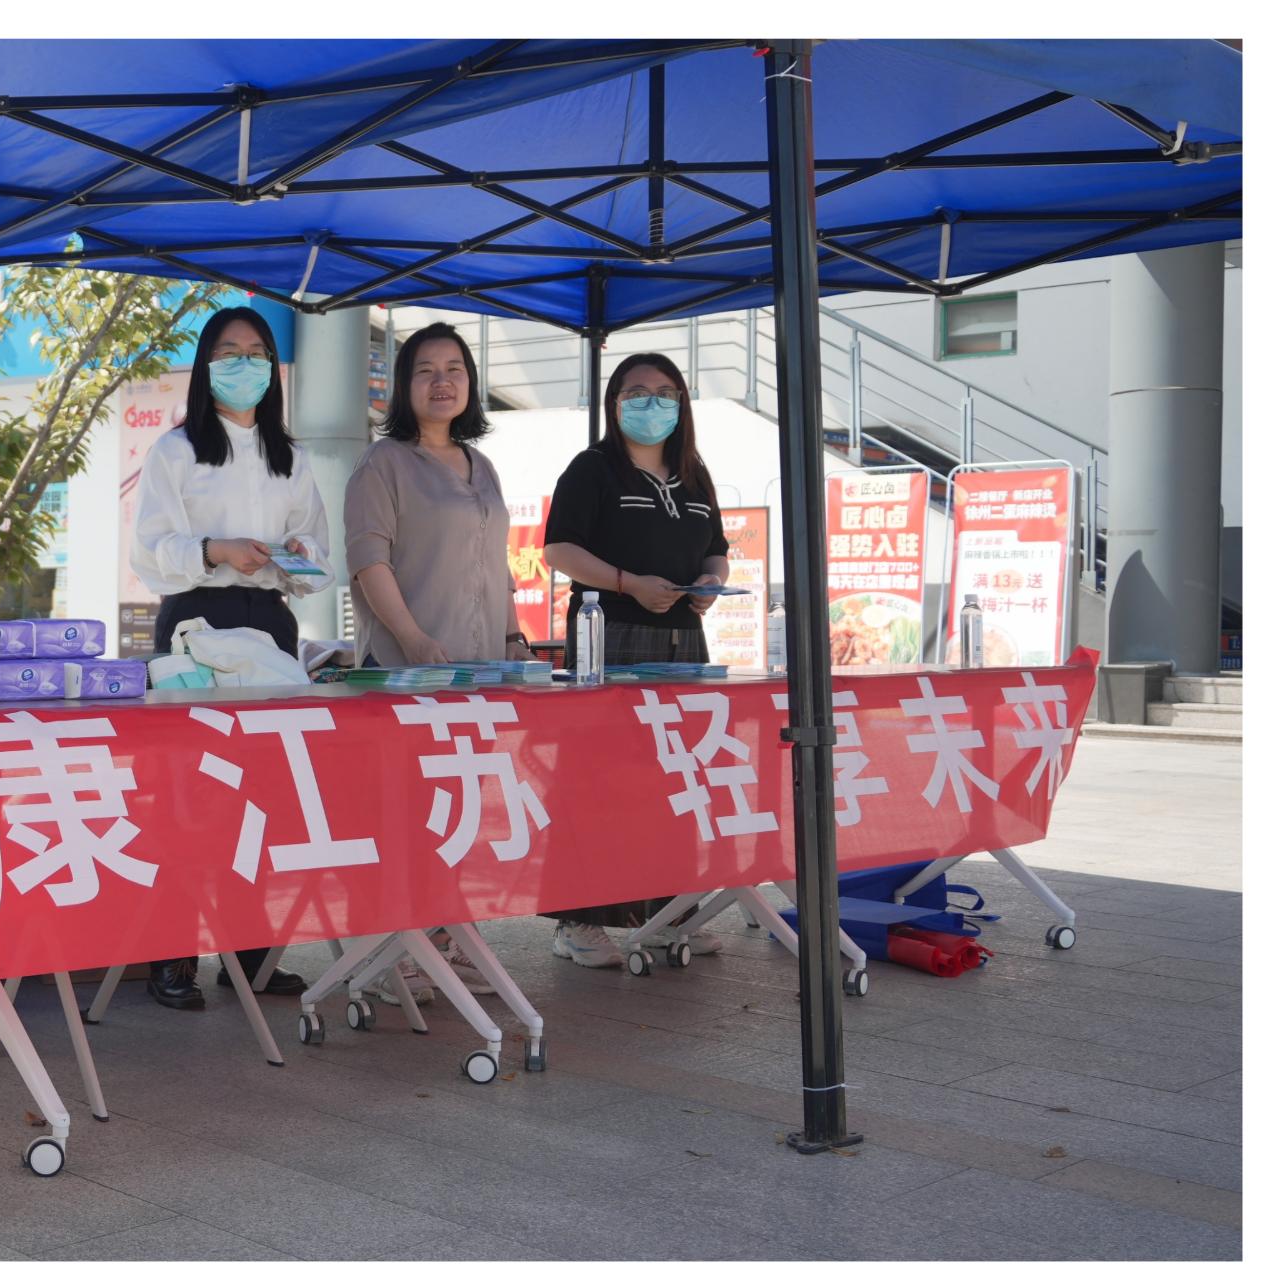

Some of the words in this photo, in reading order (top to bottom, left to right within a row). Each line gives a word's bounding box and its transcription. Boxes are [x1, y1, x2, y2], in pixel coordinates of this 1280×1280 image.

[840, 504, 909, 530] 匠心卤
[830, 533, 920, 558] 强势入驻
[978, 597, 1049, 614] 梅汁一杯
[632, 671, 1075, 842] 轻享未来
